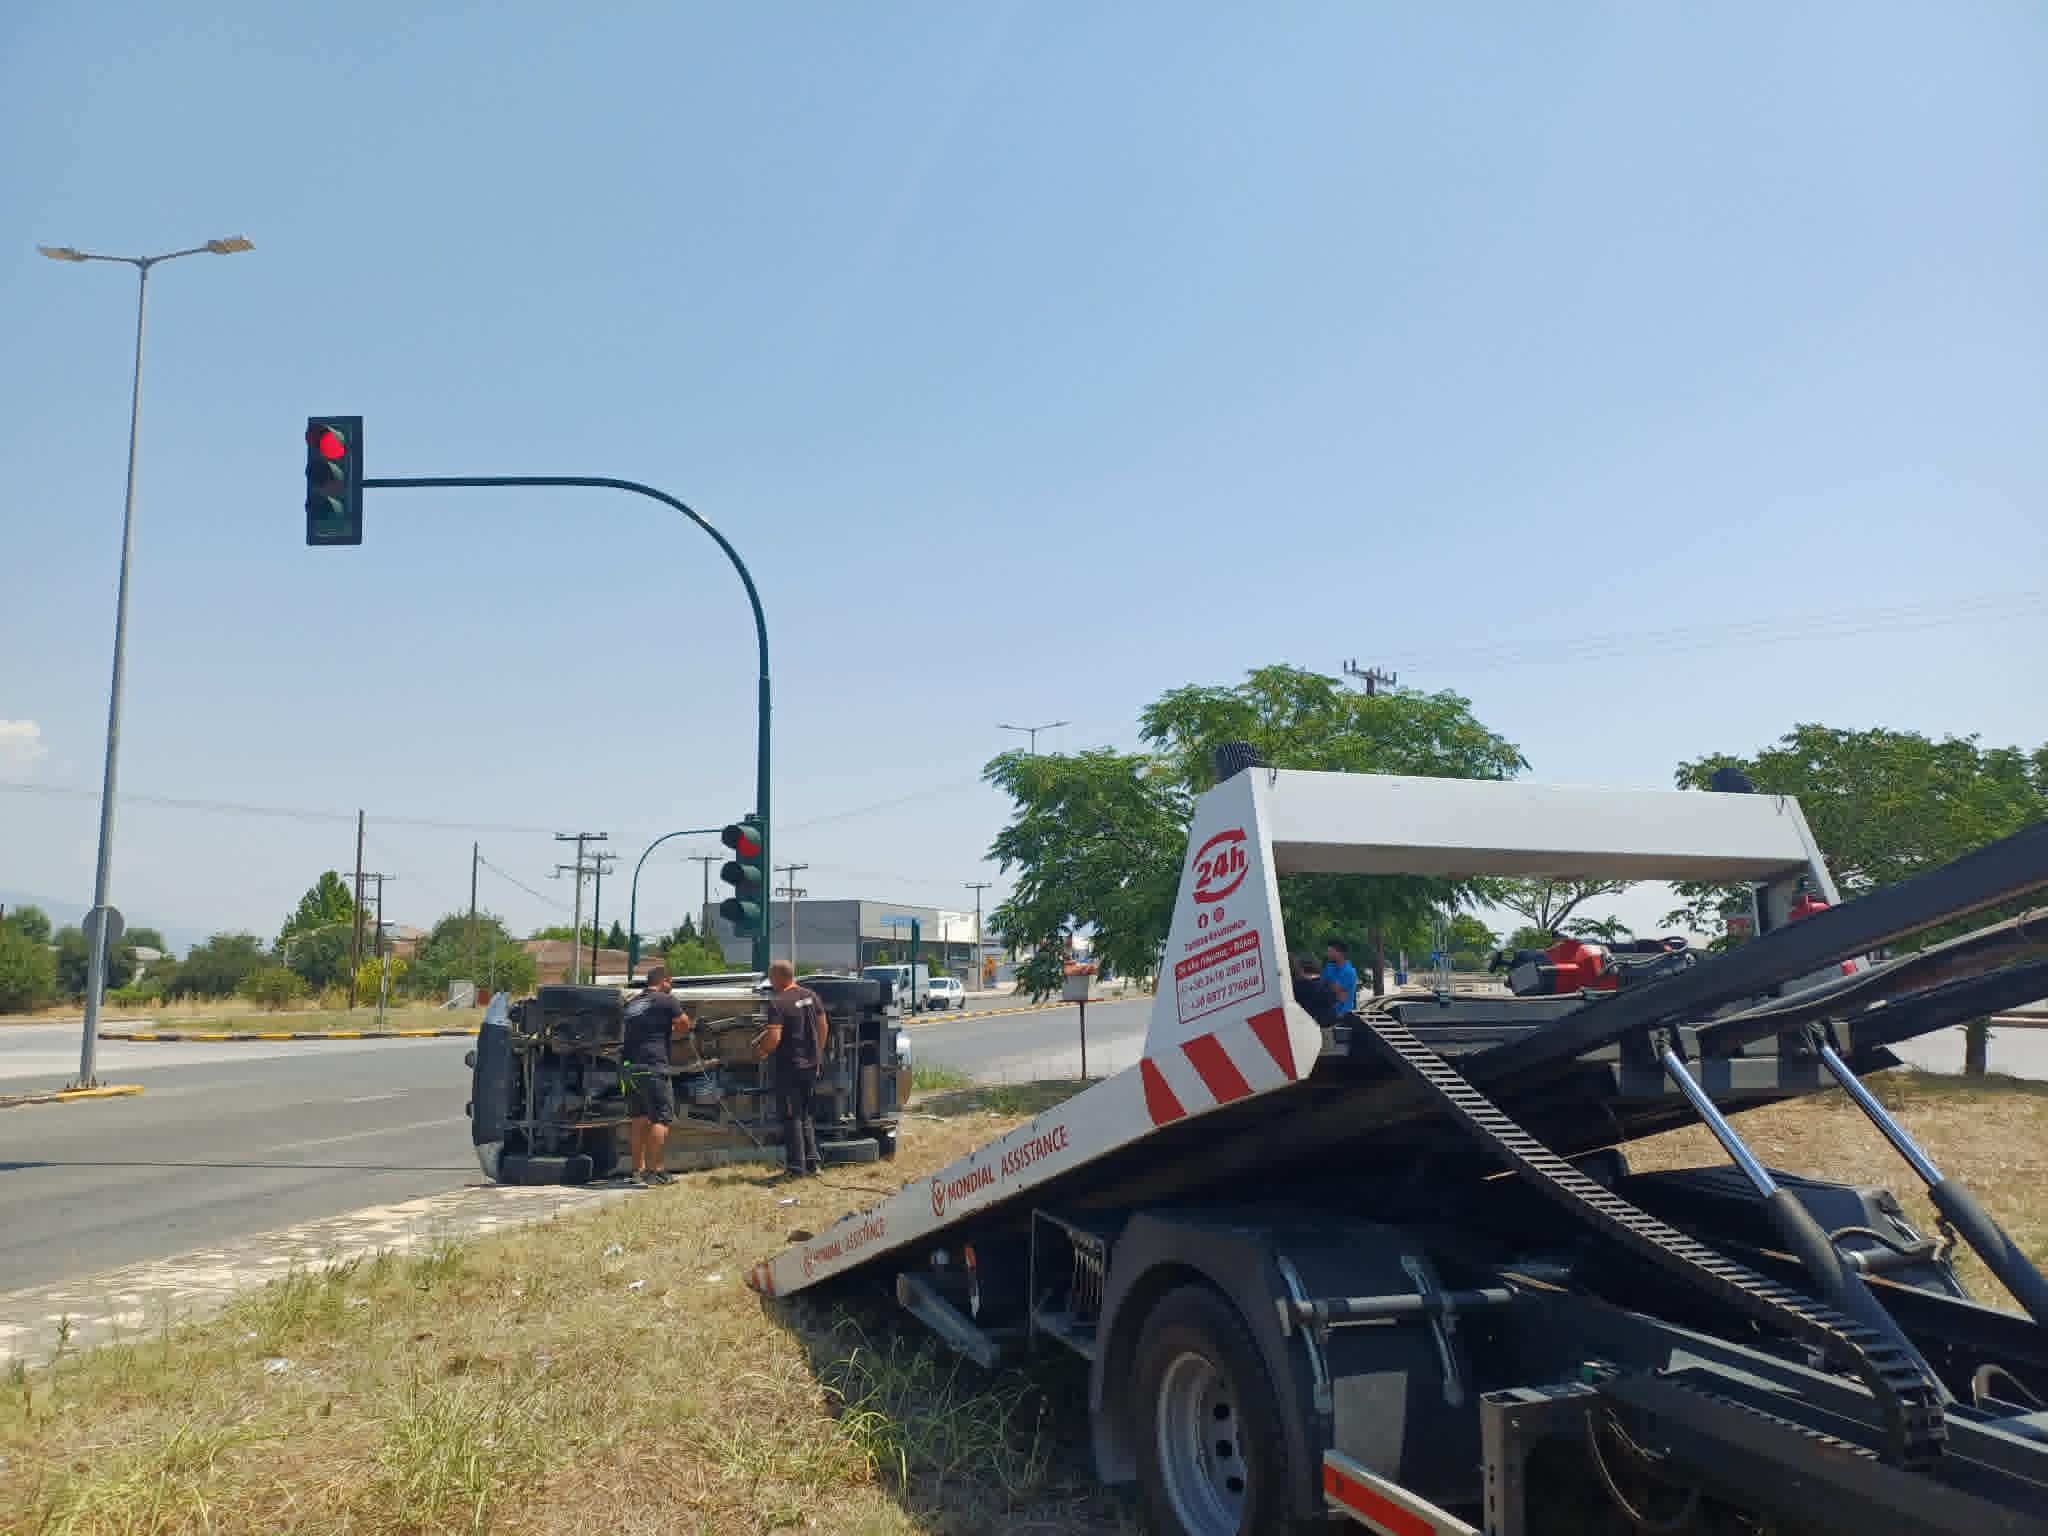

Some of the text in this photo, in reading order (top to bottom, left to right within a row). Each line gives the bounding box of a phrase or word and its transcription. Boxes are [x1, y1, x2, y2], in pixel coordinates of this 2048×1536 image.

[1196, 847, 1244, 889] 24h
[947, 1125, 1069, 1201] MONDIAL ASSISTANCE
